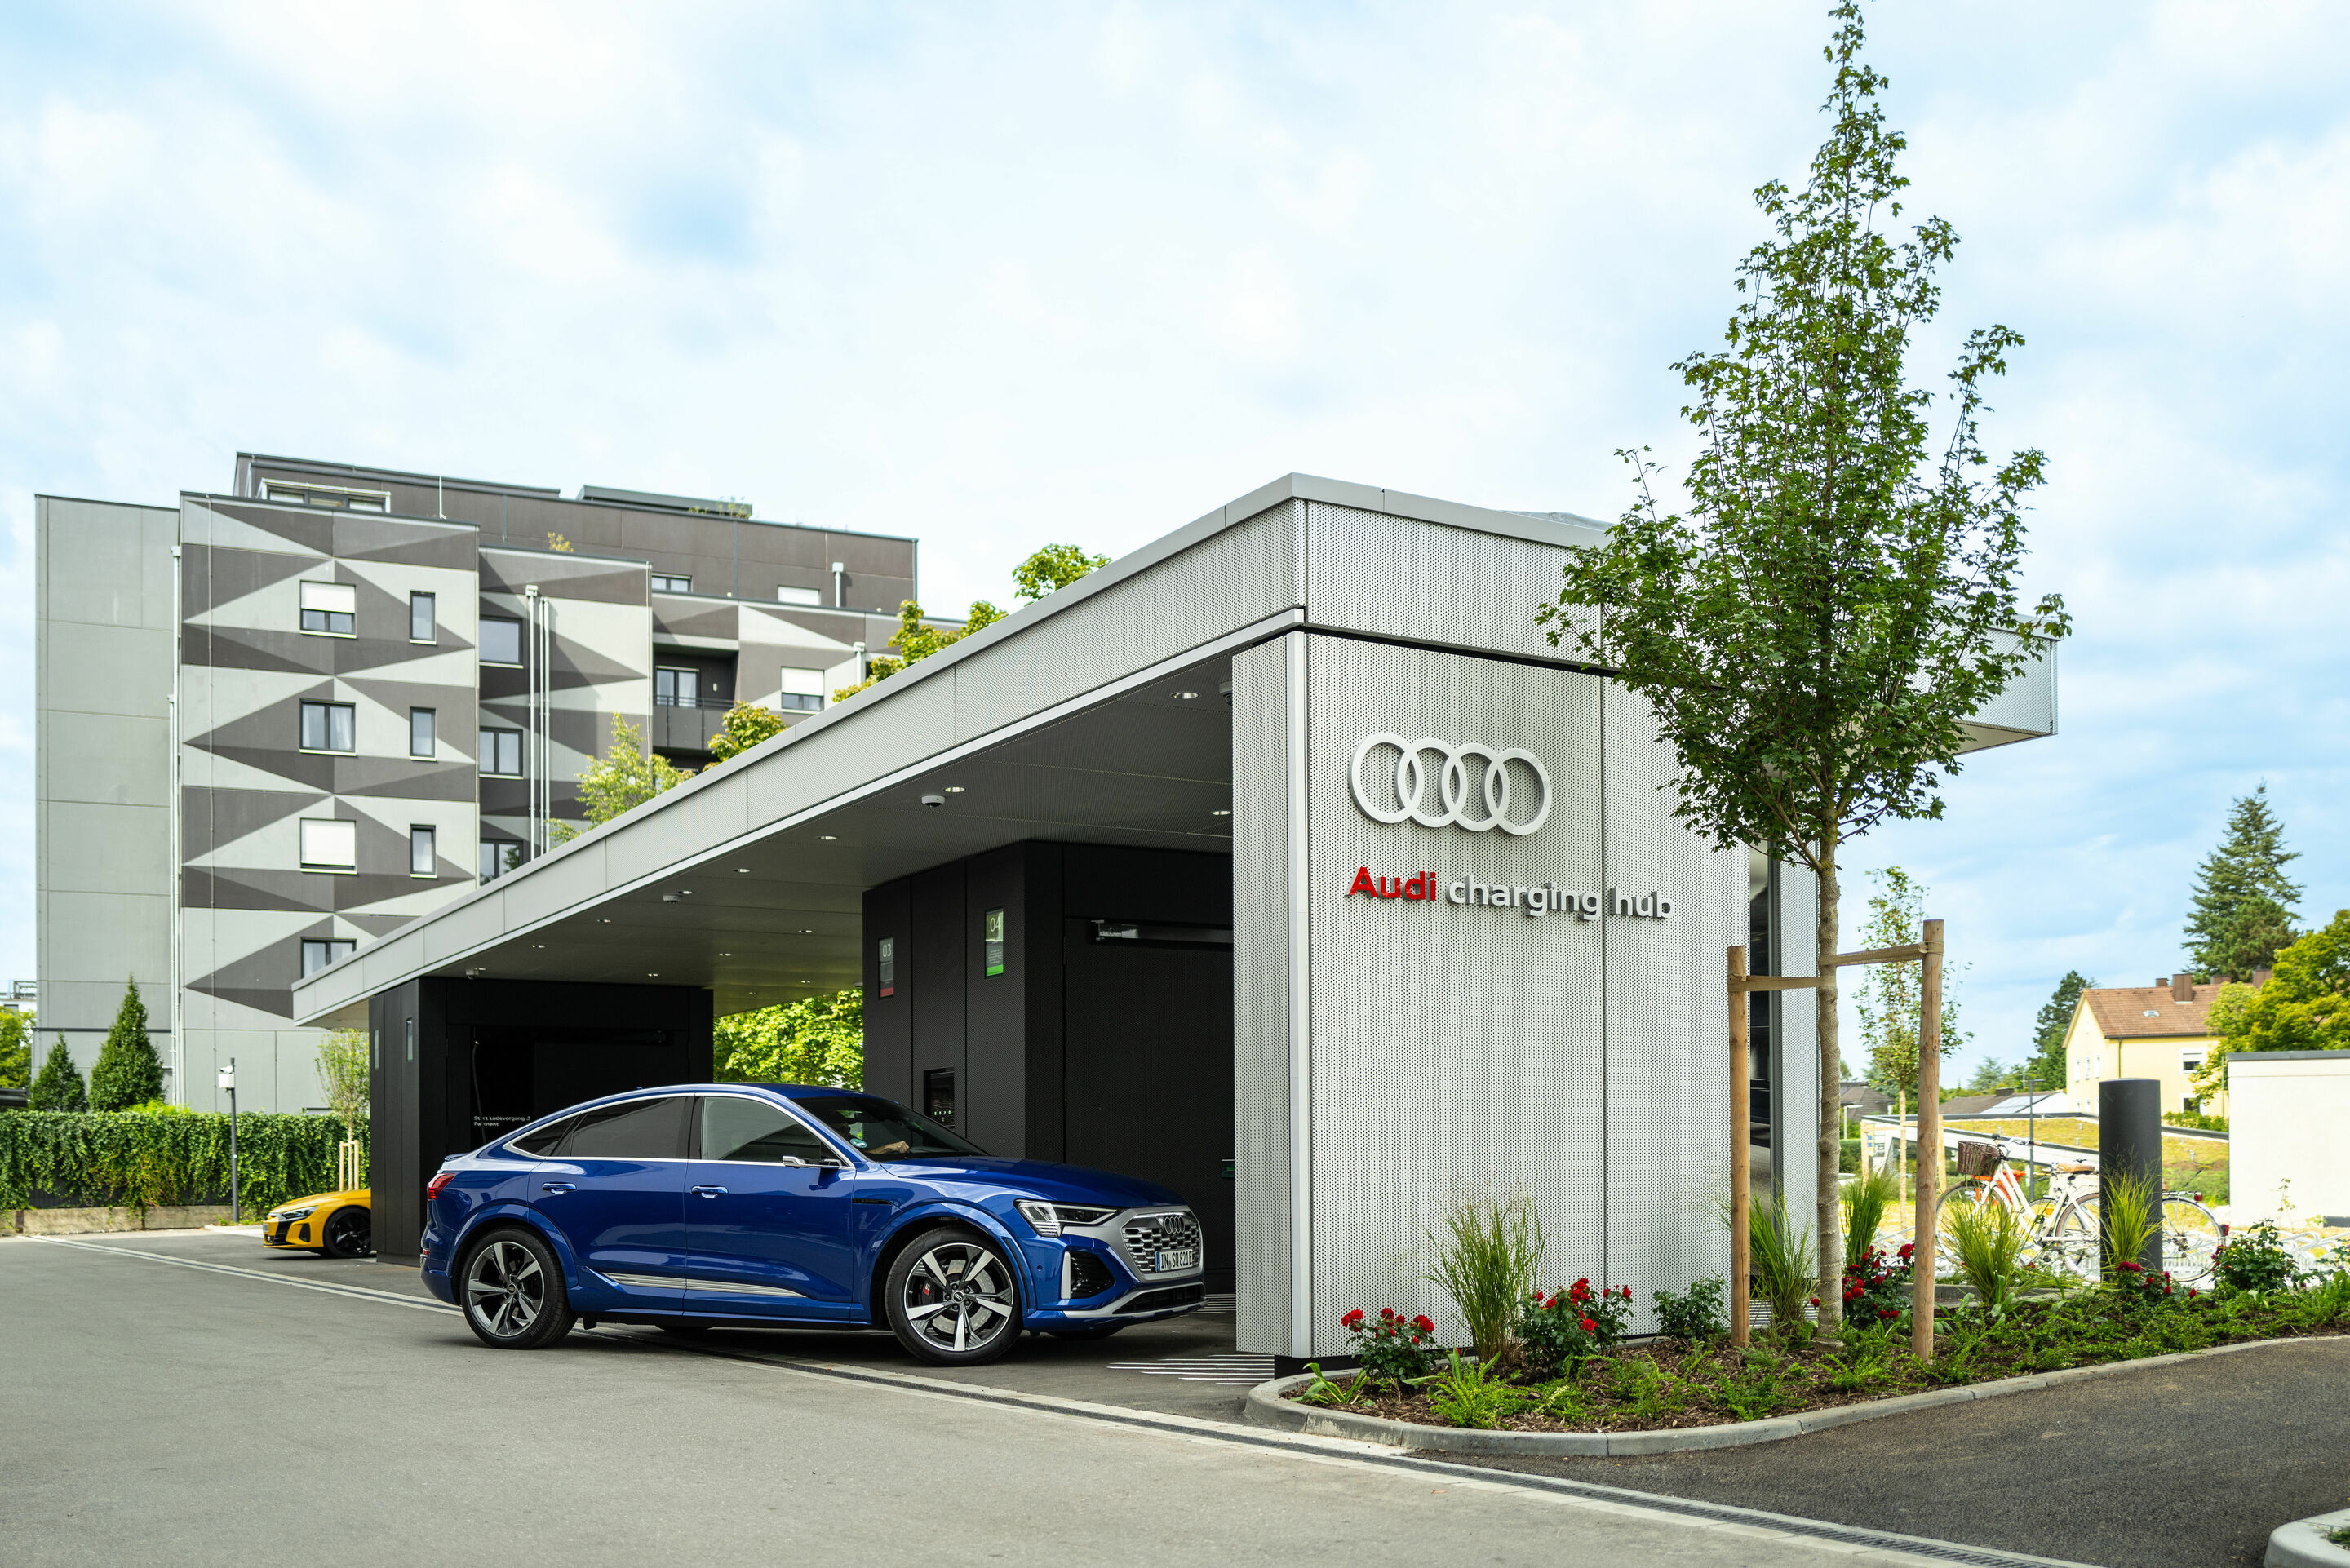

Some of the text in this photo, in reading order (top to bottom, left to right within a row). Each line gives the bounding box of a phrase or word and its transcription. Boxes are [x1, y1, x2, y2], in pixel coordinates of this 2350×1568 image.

[1346, 866, 1676, 922] Audi charging hub
[990, 915, 1001, 932] 04
[882, 943, 893, 958] 03
